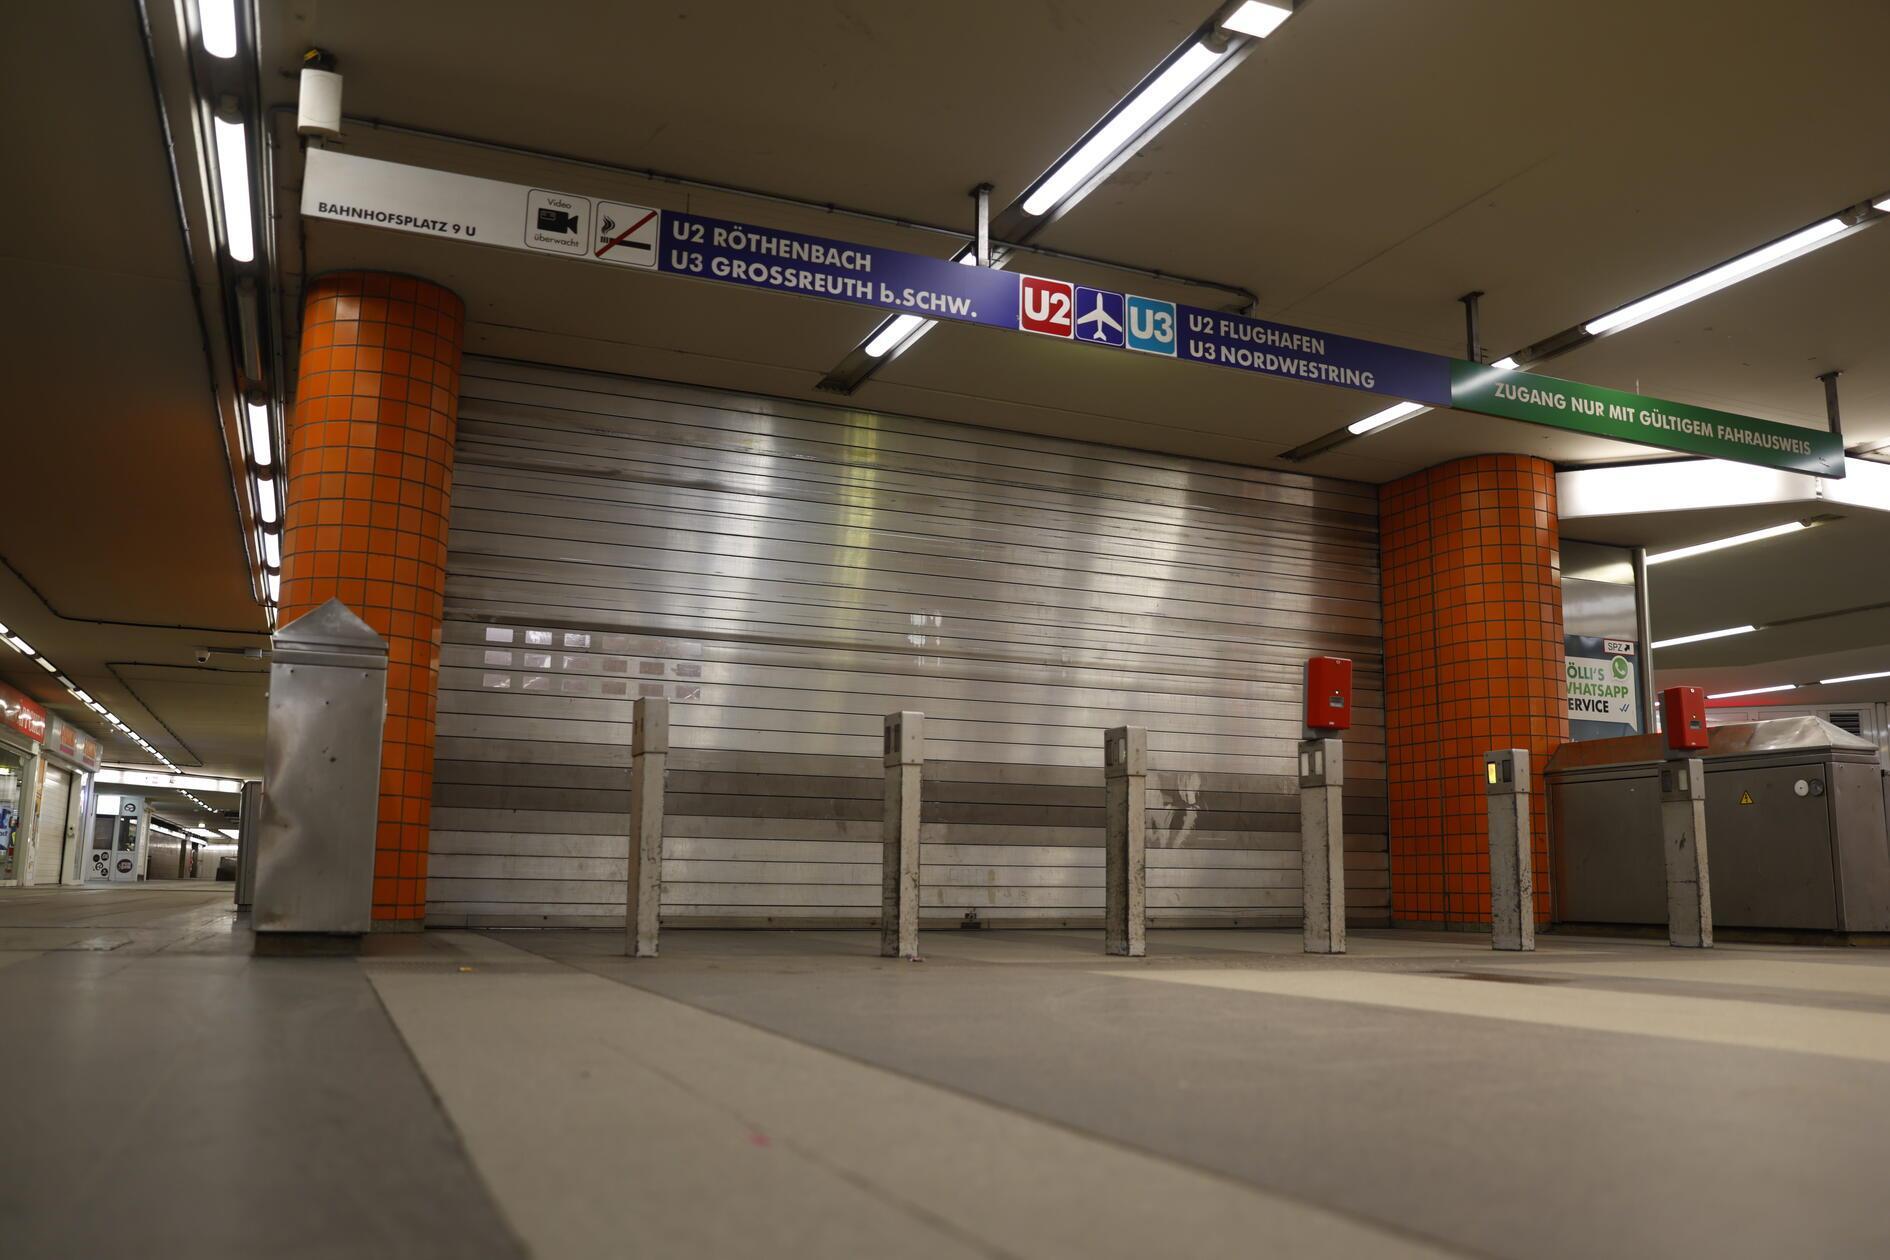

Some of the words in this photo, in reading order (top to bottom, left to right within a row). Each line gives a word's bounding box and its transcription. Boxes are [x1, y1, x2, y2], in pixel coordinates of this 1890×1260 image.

[318, 202, 448, 233] BAHNHOFSPLATZ
[452, 224, 461, 234] 9
[466, 226, 476, 237] U
[547, 198, 572, 209] Video
[534, 233, 579, 248] überwacht
[672, 220, 705, 243] U2
[713, 225, 872, 272] RÖTHENBACH
[671, 250, 703, 272] U3
[711, 256, 873, 300] GROSSREUTH
[880, 284, 978, 318] b.SCHW.
[1024, 286, 1071, 326] U2
[1130, 305, 1174, 344] U3
[1189, 314, 1214, 335] U2
[1220, 319, 1325, 356] FLUGHAFEN
[1189, 340, 1216, 360] U3
[1220, 345, 1375, 389] NORDWESTRING
[1494, 382, 1567, 410] ZUGANG
[1571, 398, 1605, 417] NUR
[1609, 404, 1635, 424] MIT
[1639, 408, 1714, 439] GÜLTIGEM
[1718, 425, 1812, 457] FAHRAUSWEIS
[1607, 642, 1623, 652] SPZ
[1567, 661, 1605, 681] ÖLLI'S
[1567, 682, 1629, 698] HATSAPP
[1568, 698, 1609, 713] ERVICE
